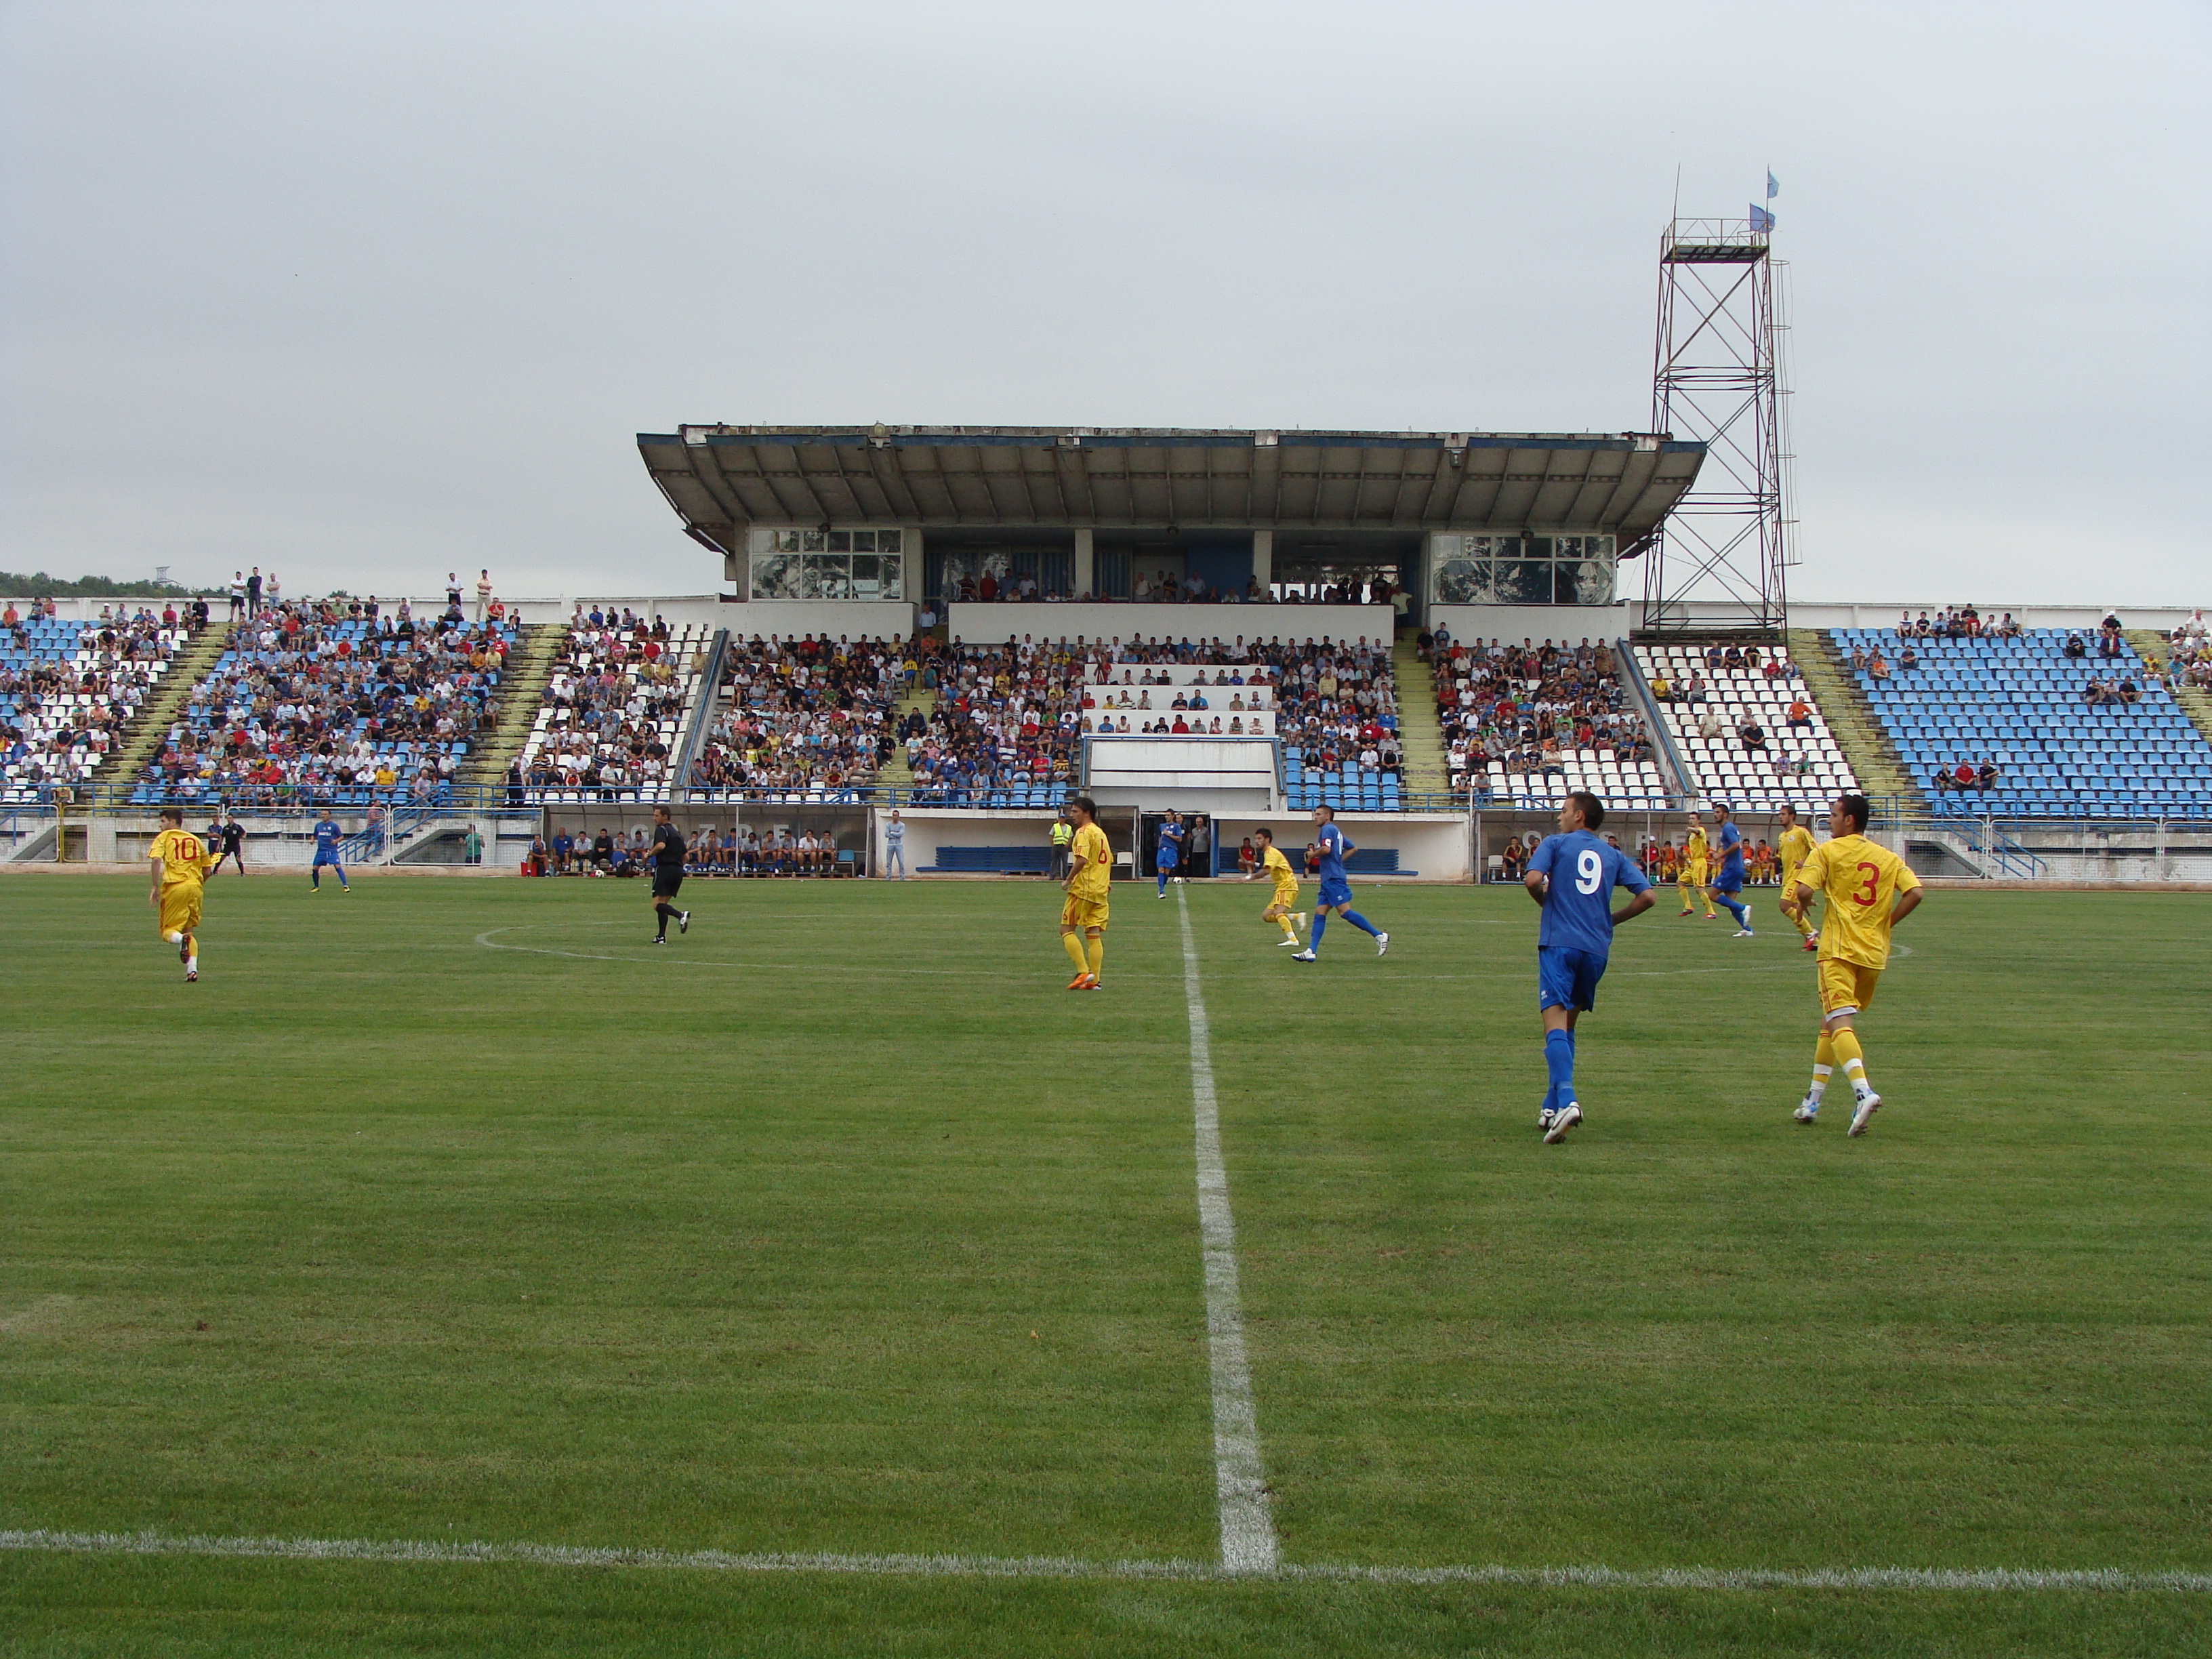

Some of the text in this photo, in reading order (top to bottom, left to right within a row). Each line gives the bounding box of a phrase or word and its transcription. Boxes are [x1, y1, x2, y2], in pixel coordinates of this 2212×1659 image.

[171, 838, 197, 860] 10
[1098, 838, 1107, 864] 6
[1575, 849, 1602, 895] 9
[1853, 862, 1880, 906] 3
[1786, 888, 1793, 897] 5
[1063, 909, 1067, 920] 6
